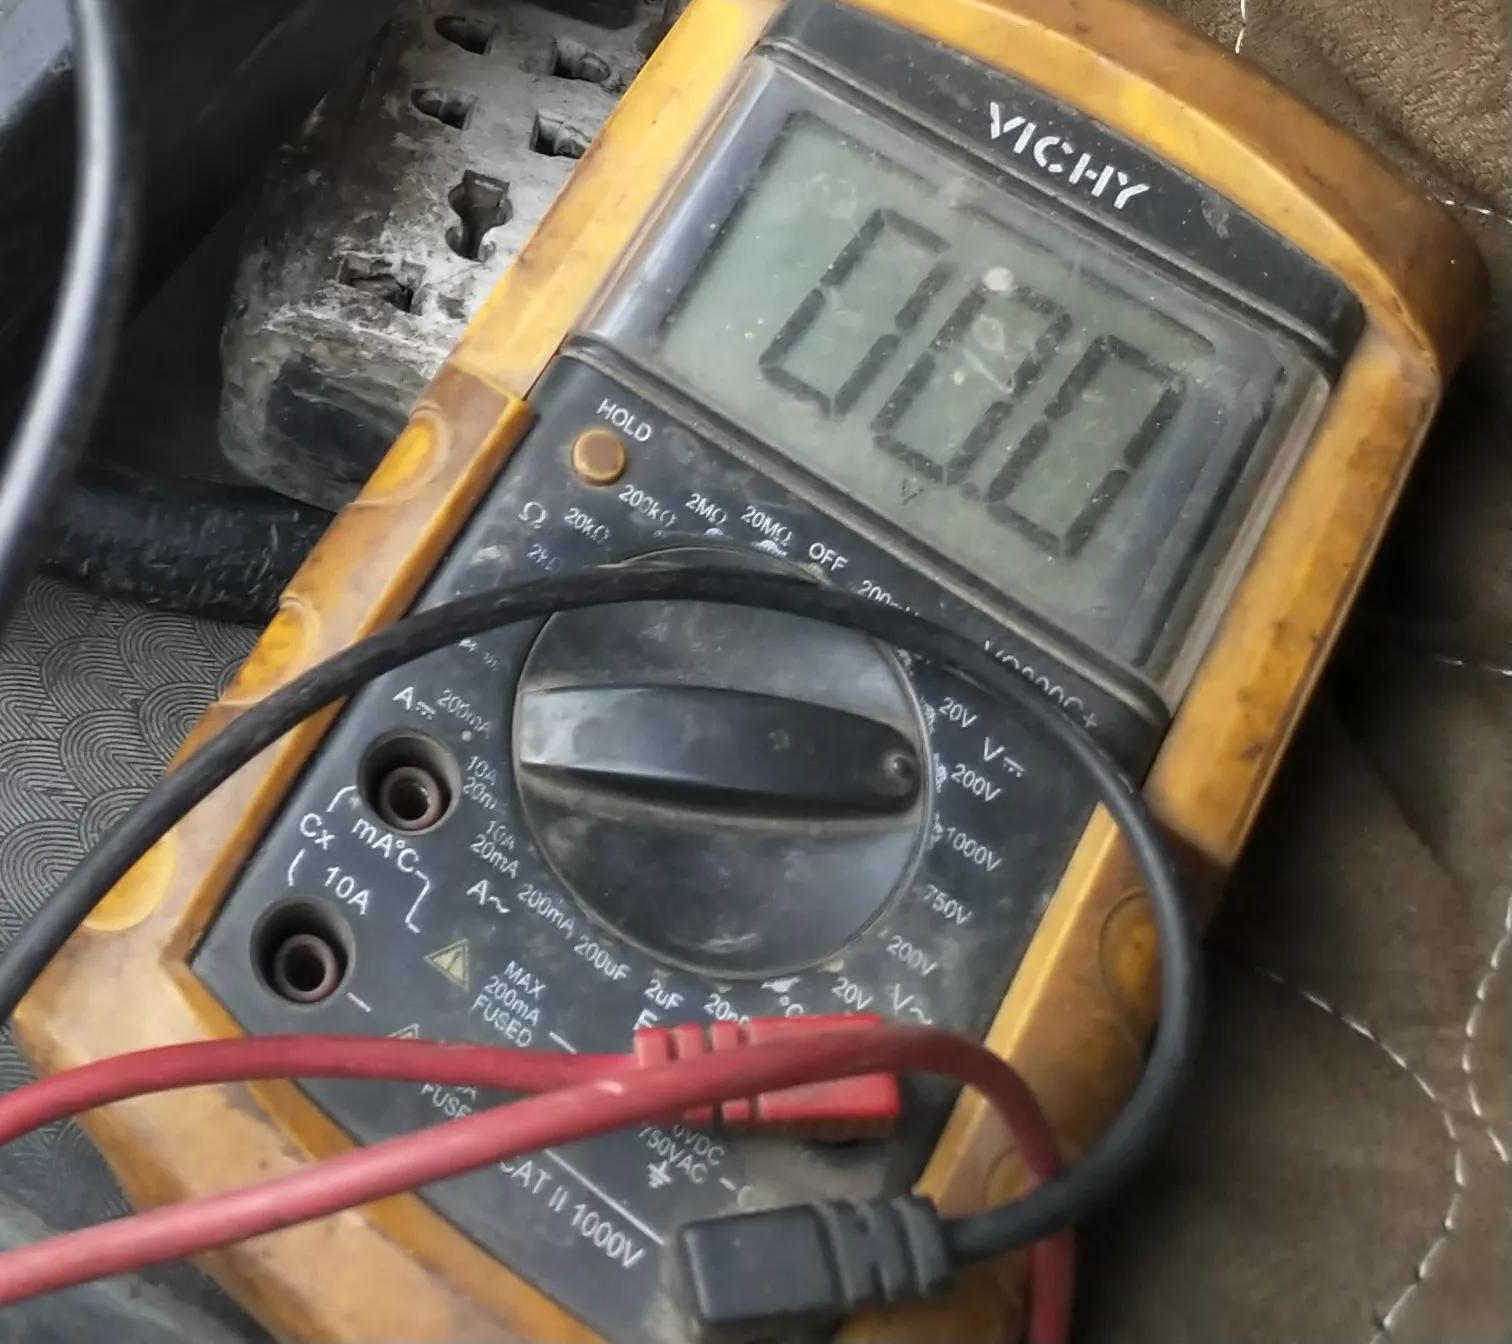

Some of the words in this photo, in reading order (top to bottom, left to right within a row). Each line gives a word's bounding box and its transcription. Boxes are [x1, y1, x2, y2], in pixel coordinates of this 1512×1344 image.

[989, 101, 1149, 210] VICHY
[597, 398, 651, 442] HOLD
[685, 493, 728, 526] 2MΩ
[741, 505, 792, 548] 20MΩ
[808, 542, 849, 571] OFF
[938, 697, 978, 728] 20V
[950, 763, 1001, 802] 200V
[470, 834, 520, 880] 20mA
[947, 827, 1002, 872] 1000V
[324, 867, 370, 915] 10A
[516, 883, 576, 940] 200mA
[923, 884, 973, 926] 750V
[886, 934, 937, 976] 200V
[485, 975, 540, 1025] 200mA
[504, 960, 546, 999] MAX
[831, 976, 873, 1010] 20V
[471, 994, 532, 1047] FUSED
[571, 1204, 644, 1268] 1000V
